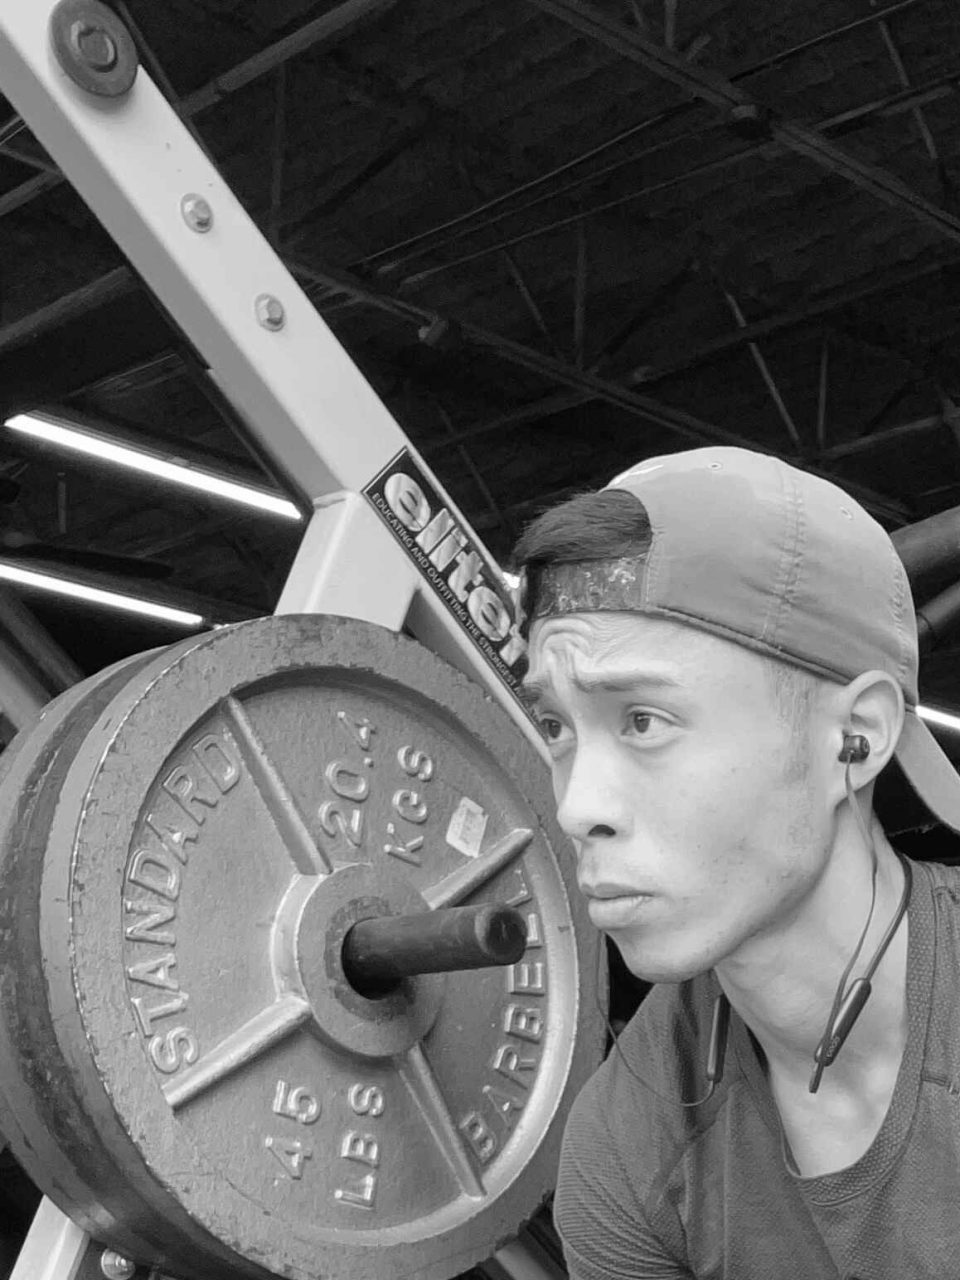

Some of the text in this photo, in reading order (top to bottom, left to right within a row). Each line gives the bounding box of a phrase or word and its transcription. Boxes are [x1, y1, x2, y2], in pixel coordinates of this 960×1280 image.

[371, 492, 414, 548] EDUCATING
[410, 547, 430, 569] AND
[427, 567, 468, 621] OUTFITTING
[464, 620, 481, 639] THE
[318, 711, 377, 848] 20.4
[125, 733, 241, 1075] STANDARD
[460, 869, 545, 1164] BARBELL
[264, 1079, 322, 1181] 45
[334, 1082, 385, 1210] LBS
